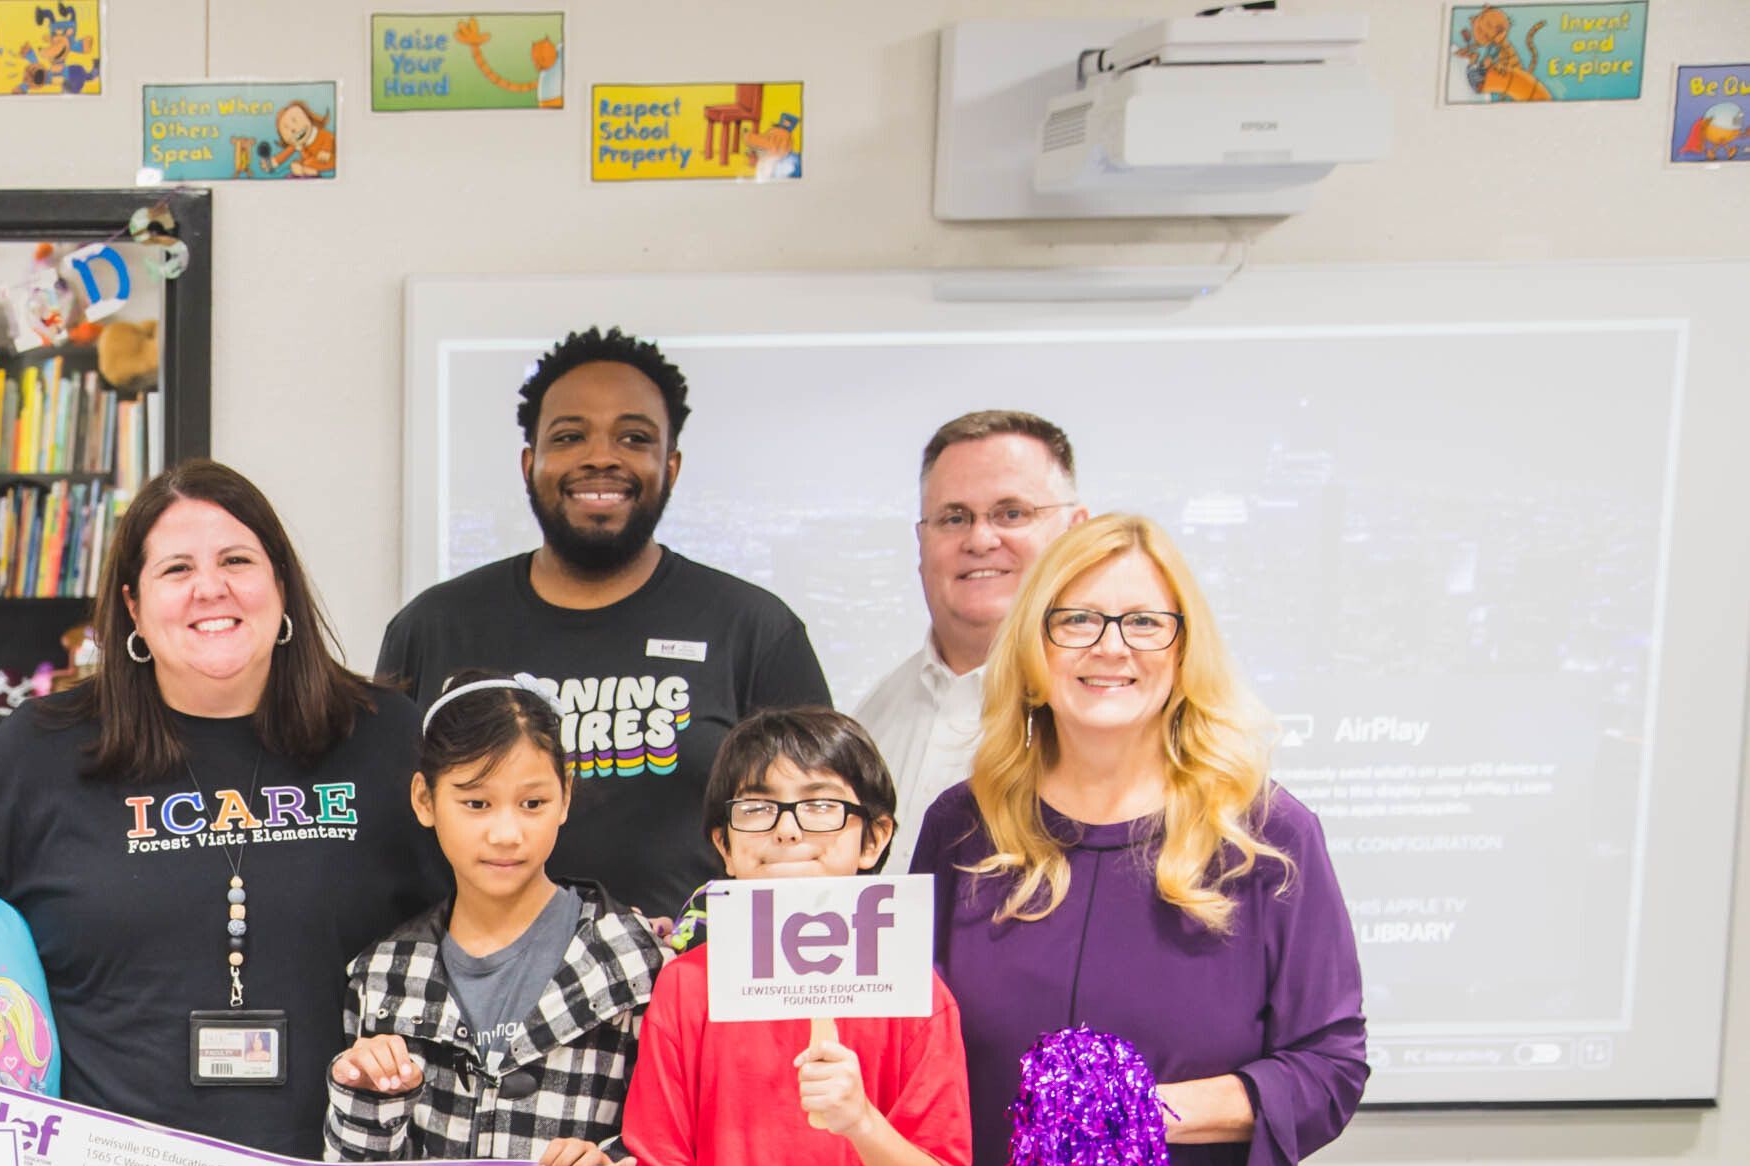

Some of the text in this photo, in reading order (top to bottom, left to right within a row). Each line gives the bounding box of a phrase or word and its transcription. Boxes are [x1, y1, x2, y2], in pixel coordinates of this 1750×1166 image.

[1561, 12, 1631, 32] Invent
[384, 30, 448, 52] Raise
[1572, 35, 1615, 53] and
[389, 53, 443, 75] Your
[1548, 58, 1633, 82] Explore
[384, 76, 449, 98] Hand
[1690, 76, 1717, 96] Be
[150, 97, 274, 116] Listen When
[599, 98, 681, 123] Respect
[151, 122, 220, 140] Others
[599, 122, 670, 142] School
[151, 145, 213, 167] Speak
[599, 145, 692, 169] Property
[559, 708, 677, 754] IRES
[1334, 716, 1431, 746] AirPlay
[127, 826, 358, 854] Forest Vista Elementary
[1356, 834, 1504, 852] CONFIGURATION
[1361, 921, 1456, 944] LIBRARY
[741, 983, 894, 997] LEWISVILLE ISD EDUCATION
[783, 994, 854, 1006] FOUNDATION
[88, 1132, 140, 1155] Lewisville
[142, 1145, 161, 1159] ISD
